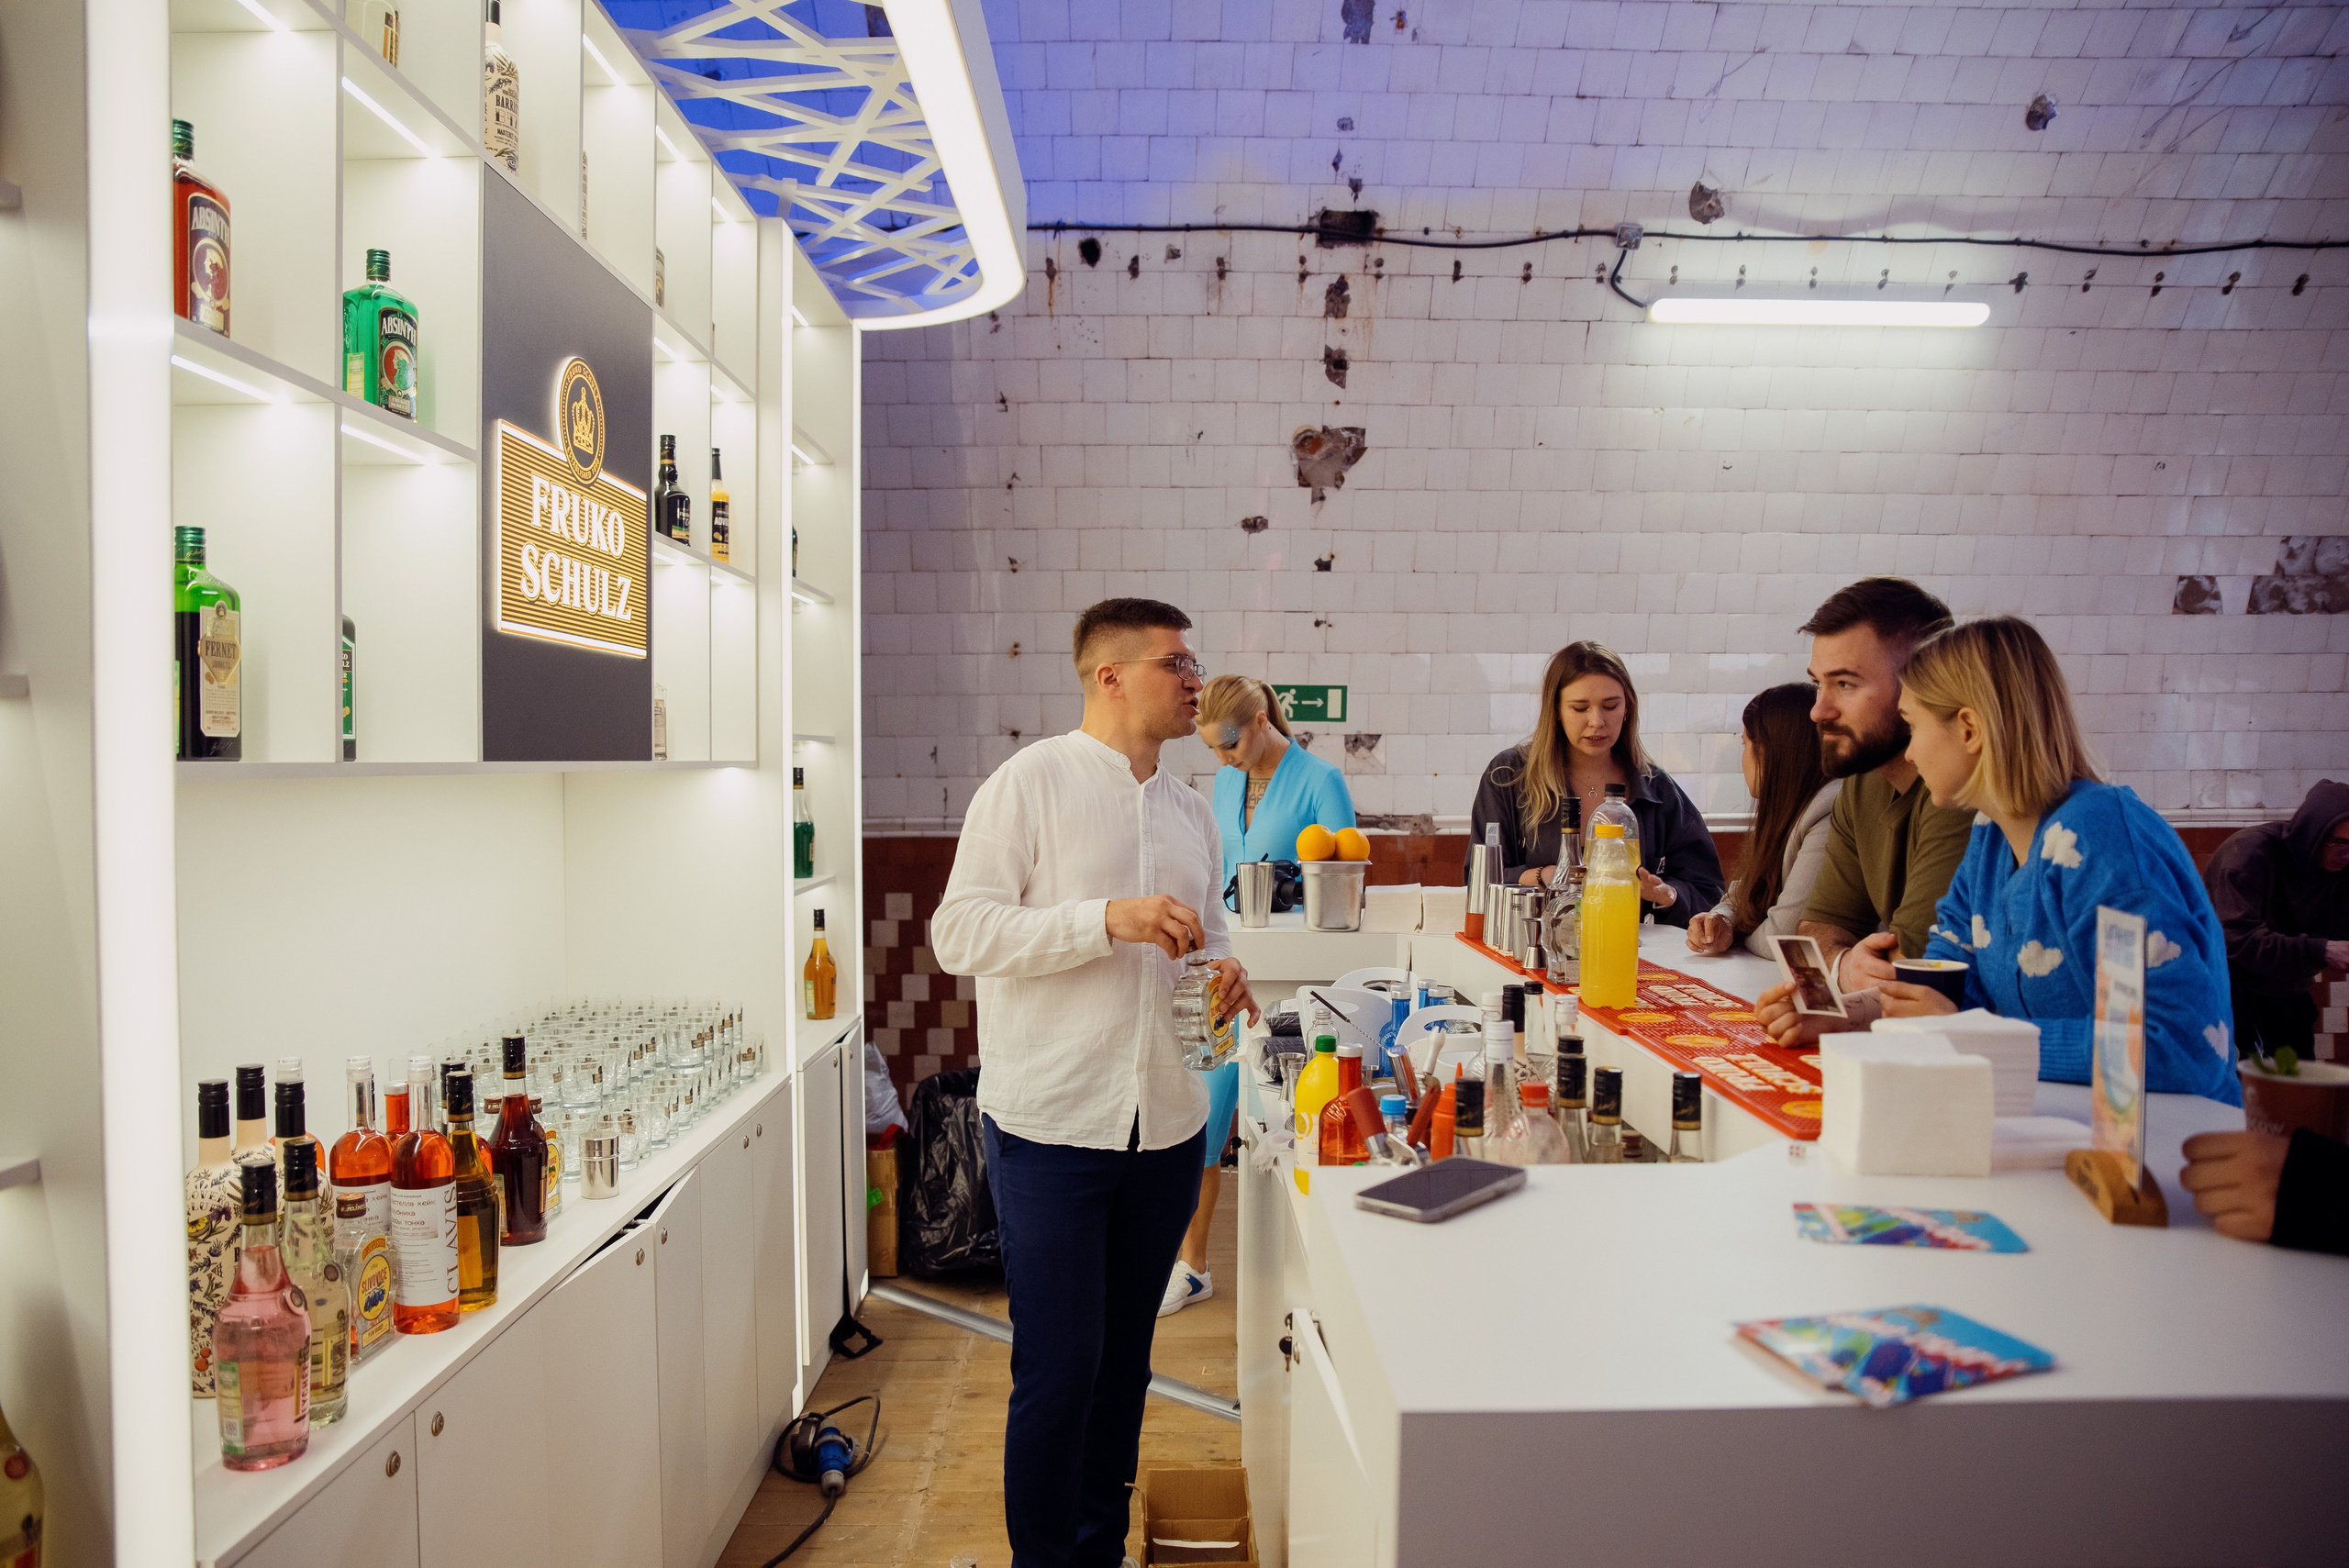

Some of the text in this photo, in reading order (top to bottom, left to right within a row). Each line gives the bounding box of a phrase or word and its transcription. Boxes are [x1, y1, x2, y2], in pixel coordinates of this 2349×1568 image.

[191, 206, 229, 248] ABSINTH
[381, 317, 416, 347] ABSINTH
[567, 365, 599, 401] FRUKO SCHULZ
[566, 446, 592, 479] ESTABLISHED
[531, 474, 625, 558] FRUKO
[521, 543, 631, 621] SCHULZ
[206, 640, 236, 659] FERNET
[362, 1266, 387, 1294] SLIVOVICE
